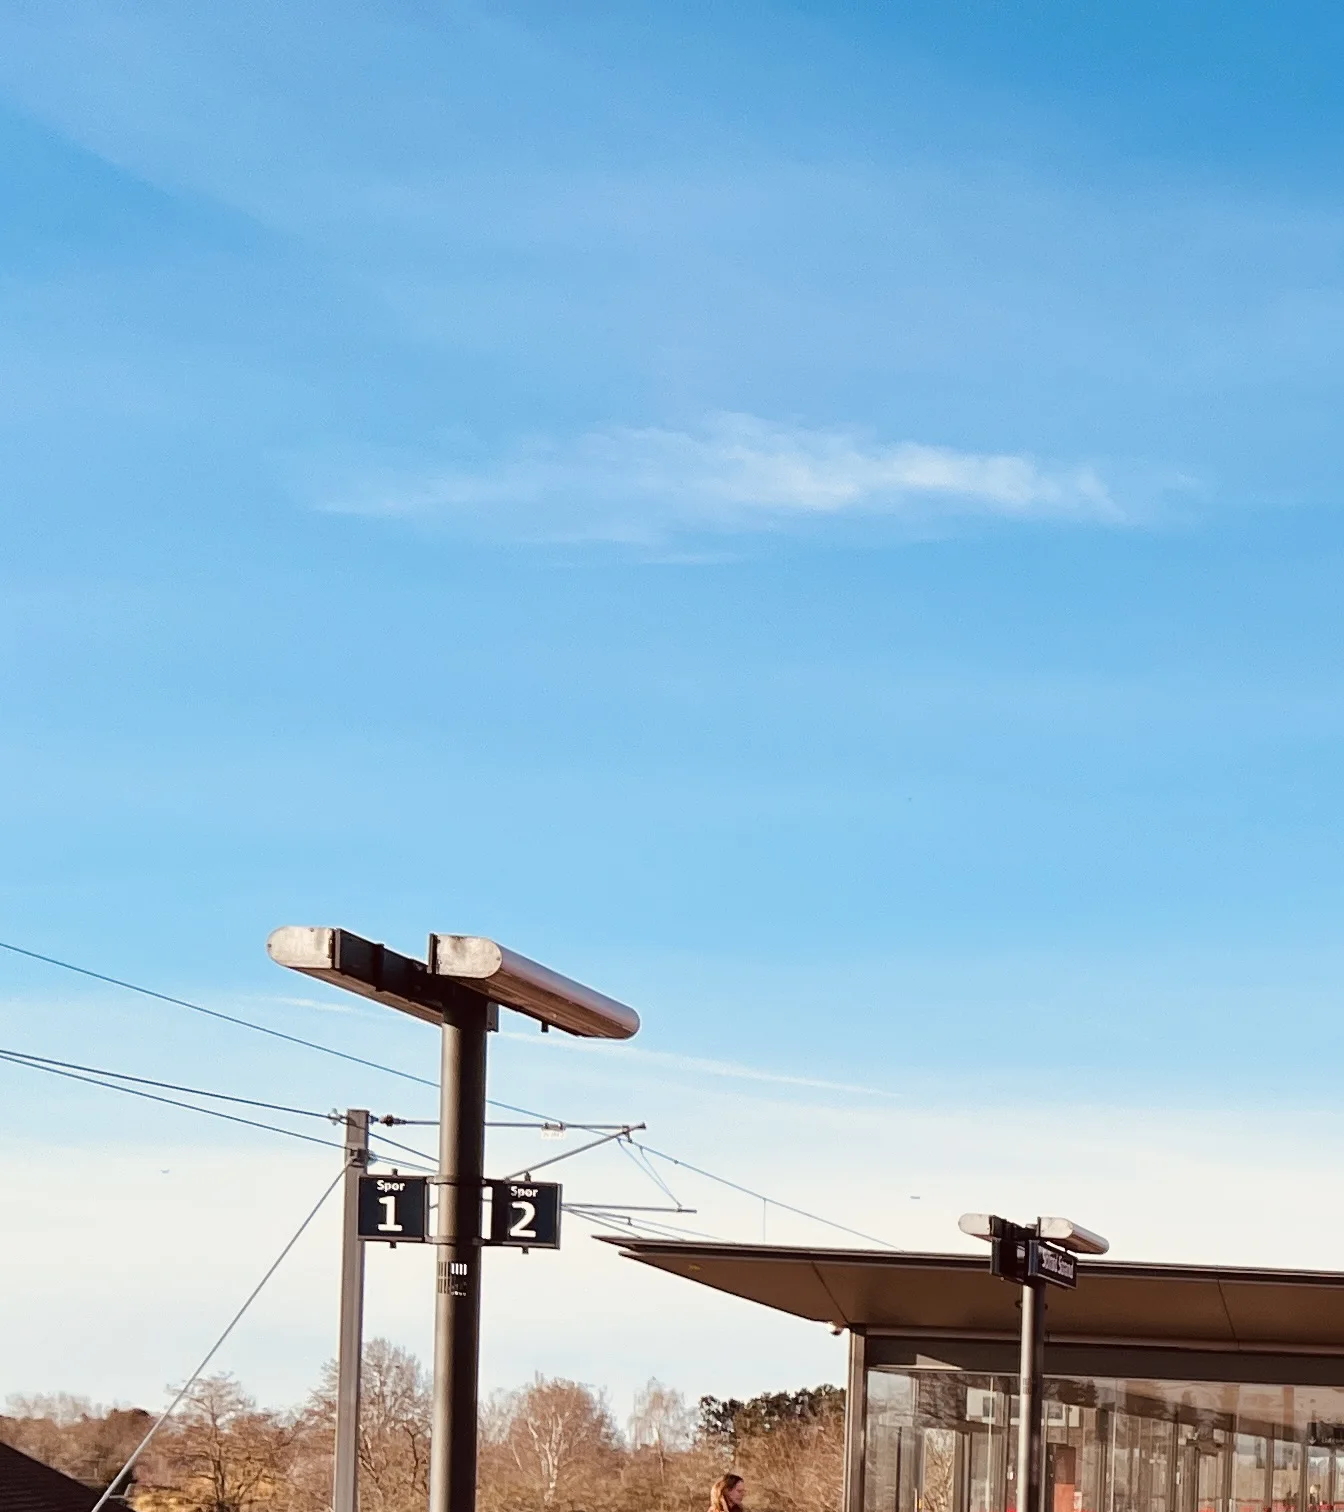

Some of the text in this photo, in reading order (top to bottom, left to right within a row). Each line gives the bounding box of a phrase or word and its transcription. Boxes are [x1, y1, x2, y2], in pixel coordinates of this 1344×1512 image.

[376, 1179, 406, 1194] Spor
[510, 1185, 539, 1200] Spor
[377, 1195, 403, 1232] 1
[509, 1201, 537, 1238] 2
